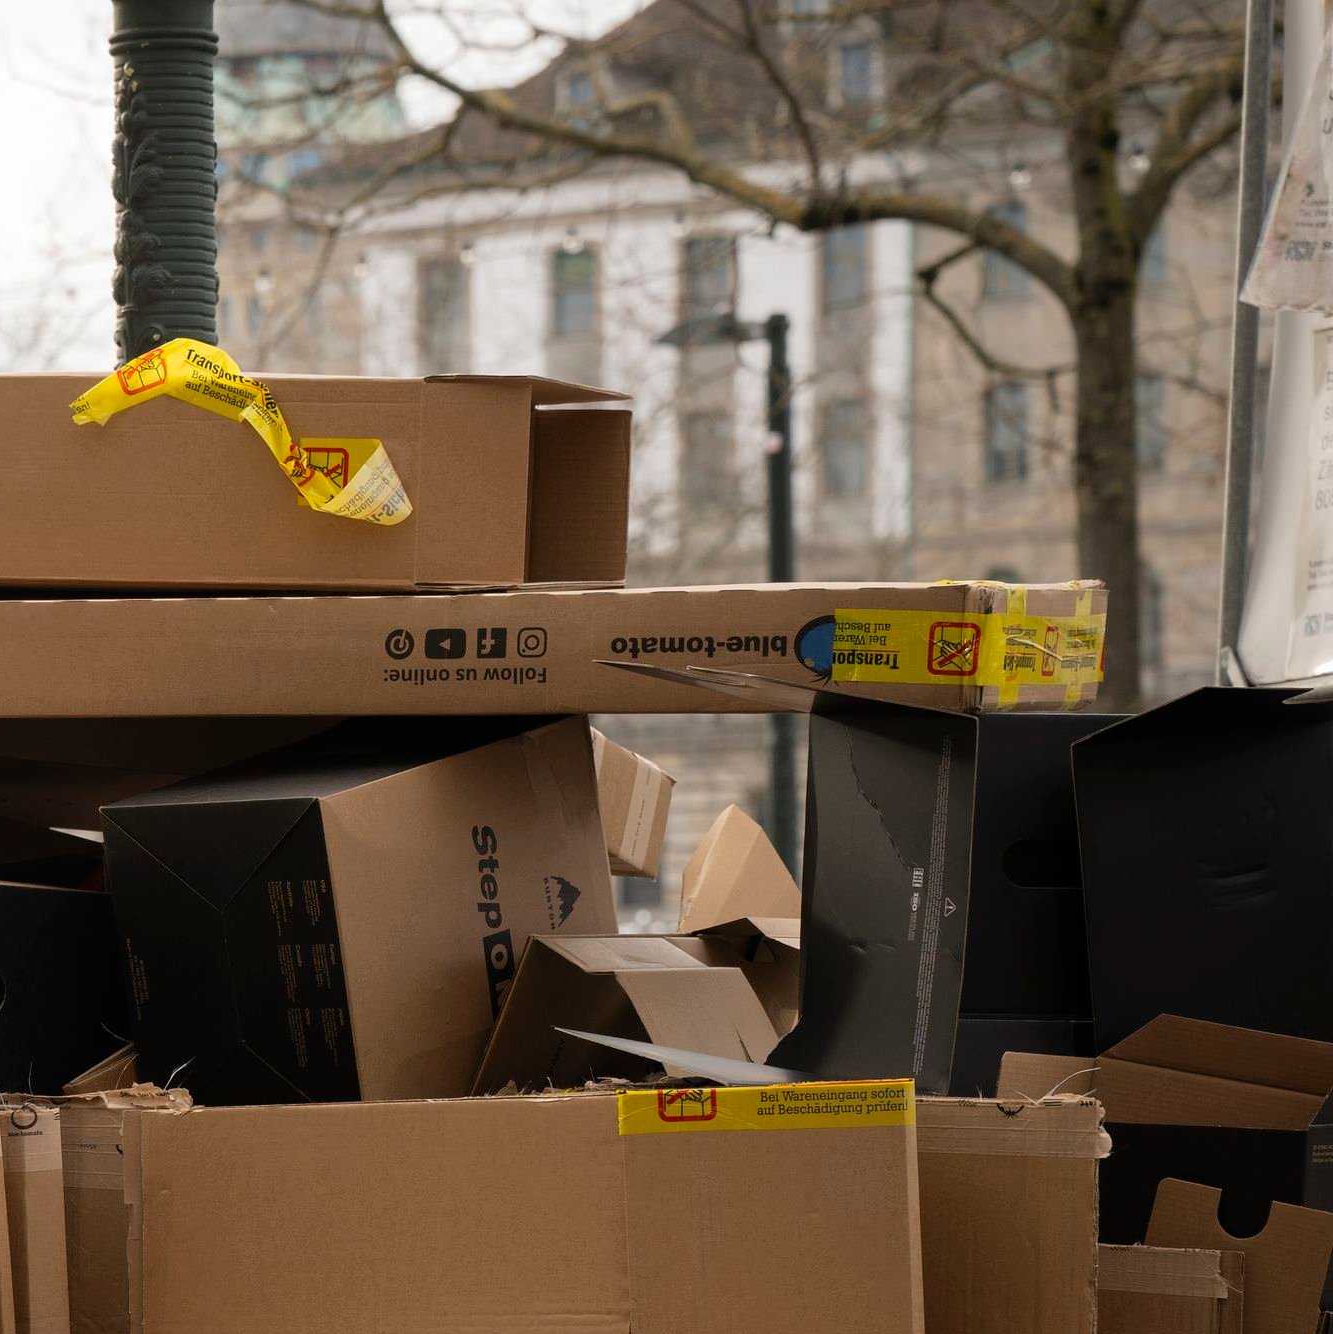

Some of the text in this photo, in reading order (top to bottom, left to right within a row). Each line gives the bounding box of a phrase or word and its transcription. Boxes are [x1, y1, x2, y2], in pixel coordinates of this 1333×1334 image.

[185, 380, 250, 410] auf Beschädi
[835, 622, 892, 634] auf Besch
[611, 636, 788, 659] blue-tomato
[868, 635, 887, 646] Bei
[383, 667, 547, 686] Follow us online:
[471, 824, 504, 929] Step
[542, 876, 556, 931] BURTON
[760, 1087, 905, 1103] Bei Wareneingang sofort
[756, 1104, 776, 1116] auf
[778, 1102, 863, 1116] Beschädigung
